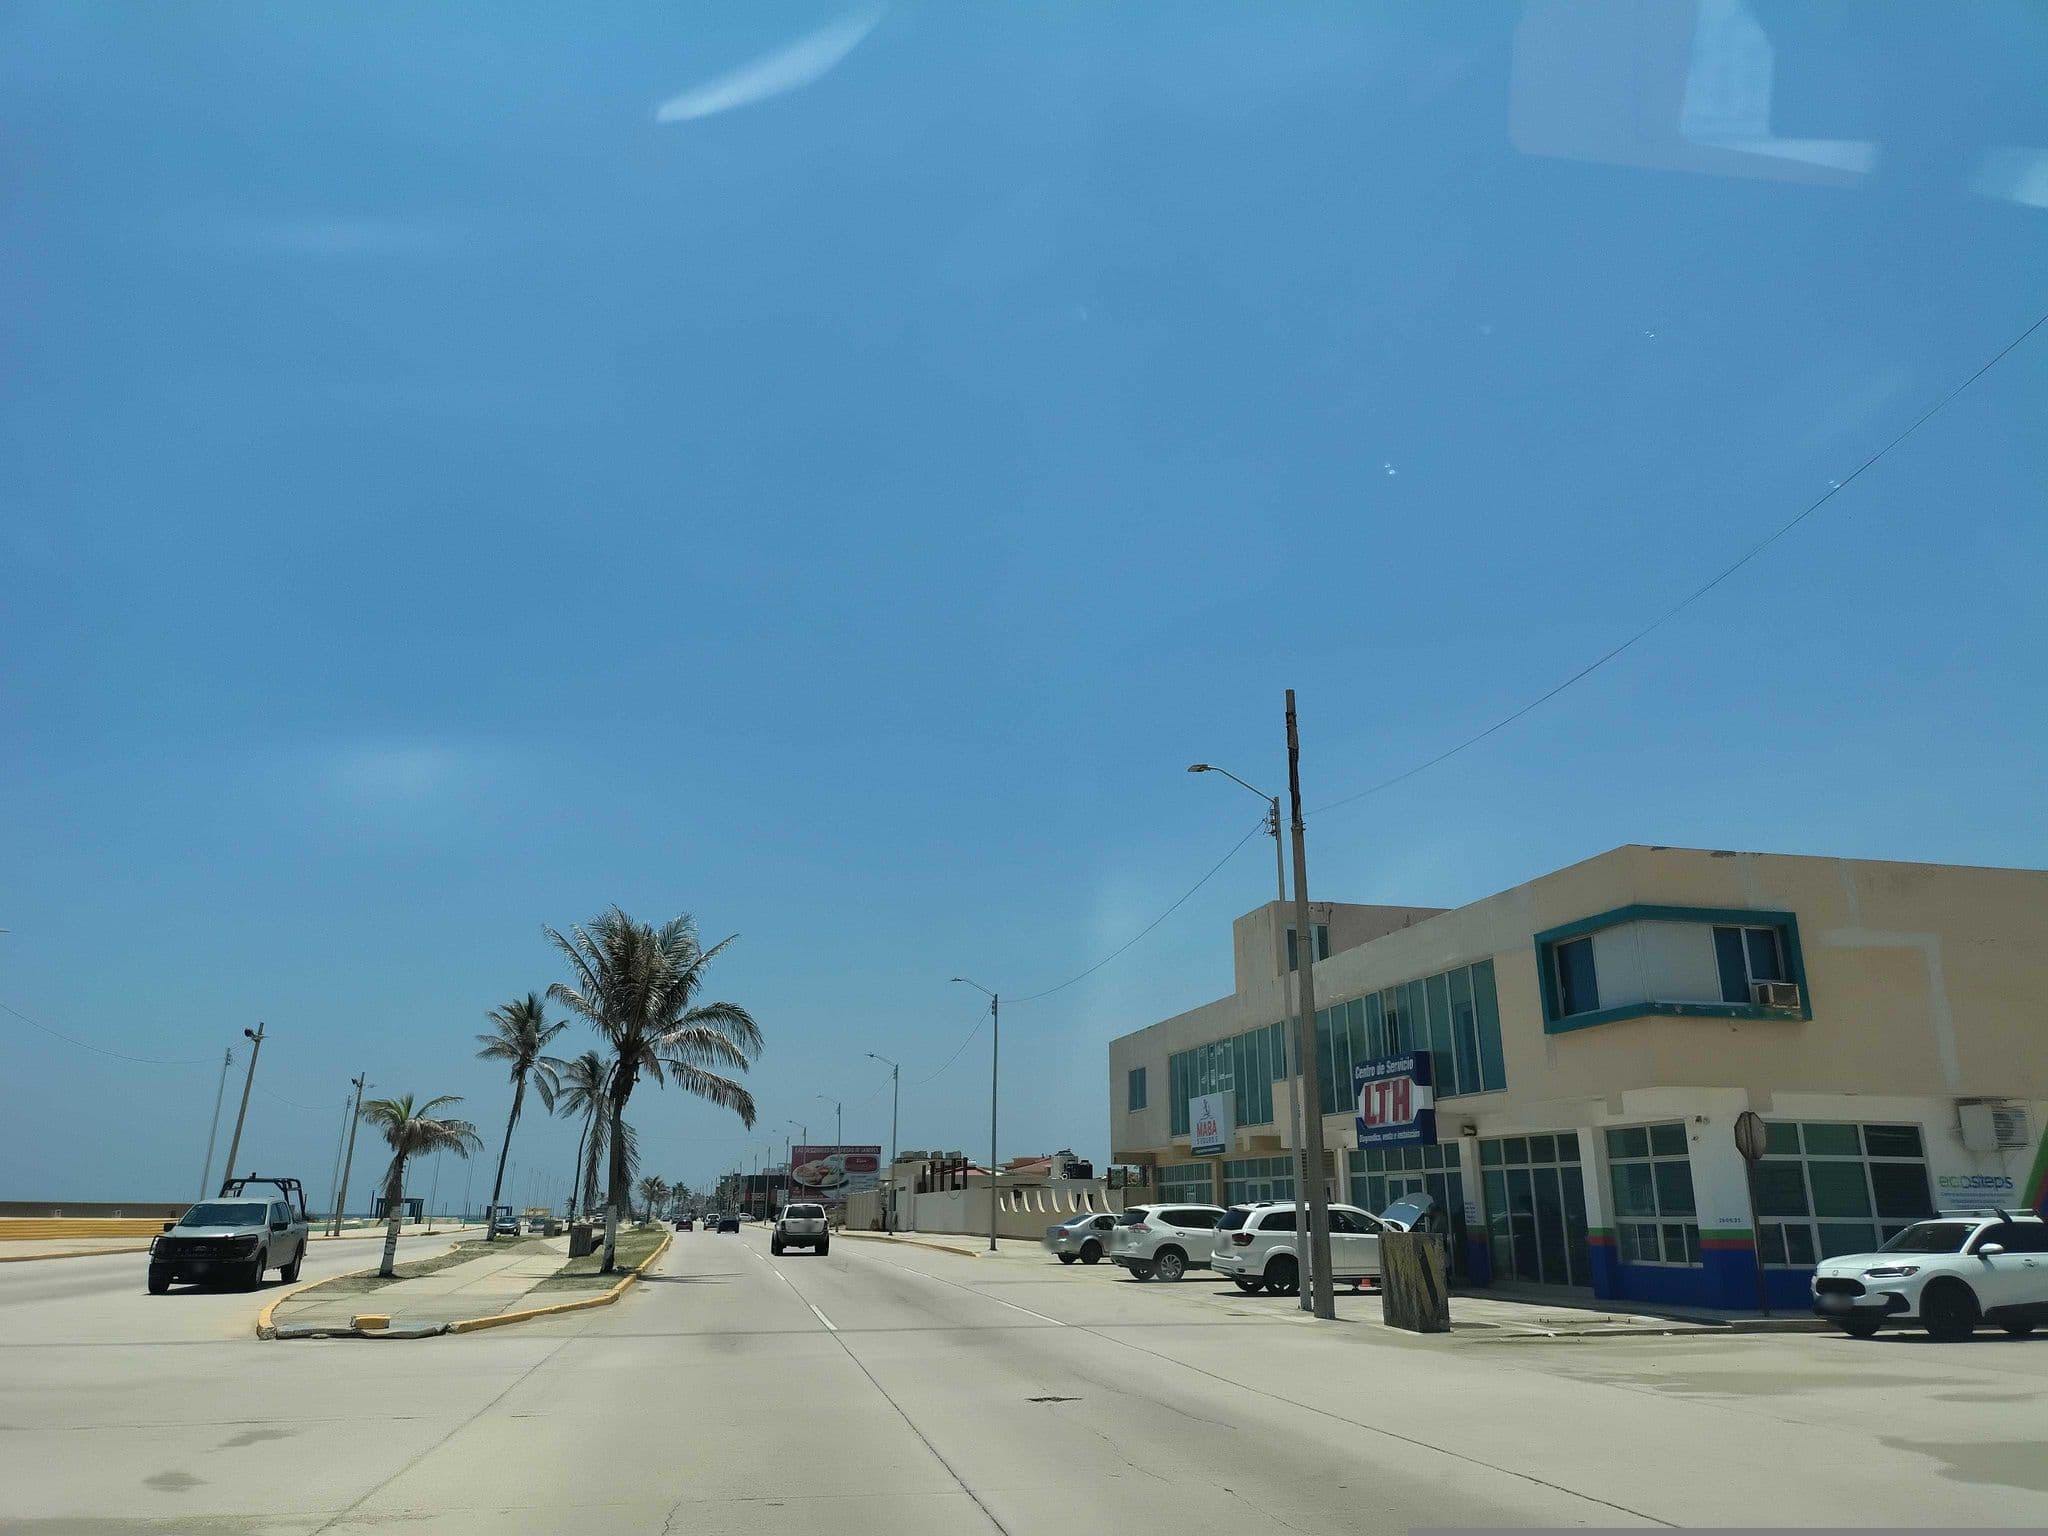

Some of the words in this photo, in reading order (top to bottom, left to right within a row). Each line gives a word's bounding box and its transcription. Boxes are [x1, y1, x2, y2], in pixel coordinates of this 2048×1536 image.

[1355, 1064, 1376, 1079] Centro
[1376, 1062, 1386, 1075] de
[1386, 1056, 1414, 1074] Servicio
[1364, 1079, 1410, 1126] LTH
[1196, 1120, 1217, 1137] MABA
[1939, 1174, 2013, 1191] ecosteps
